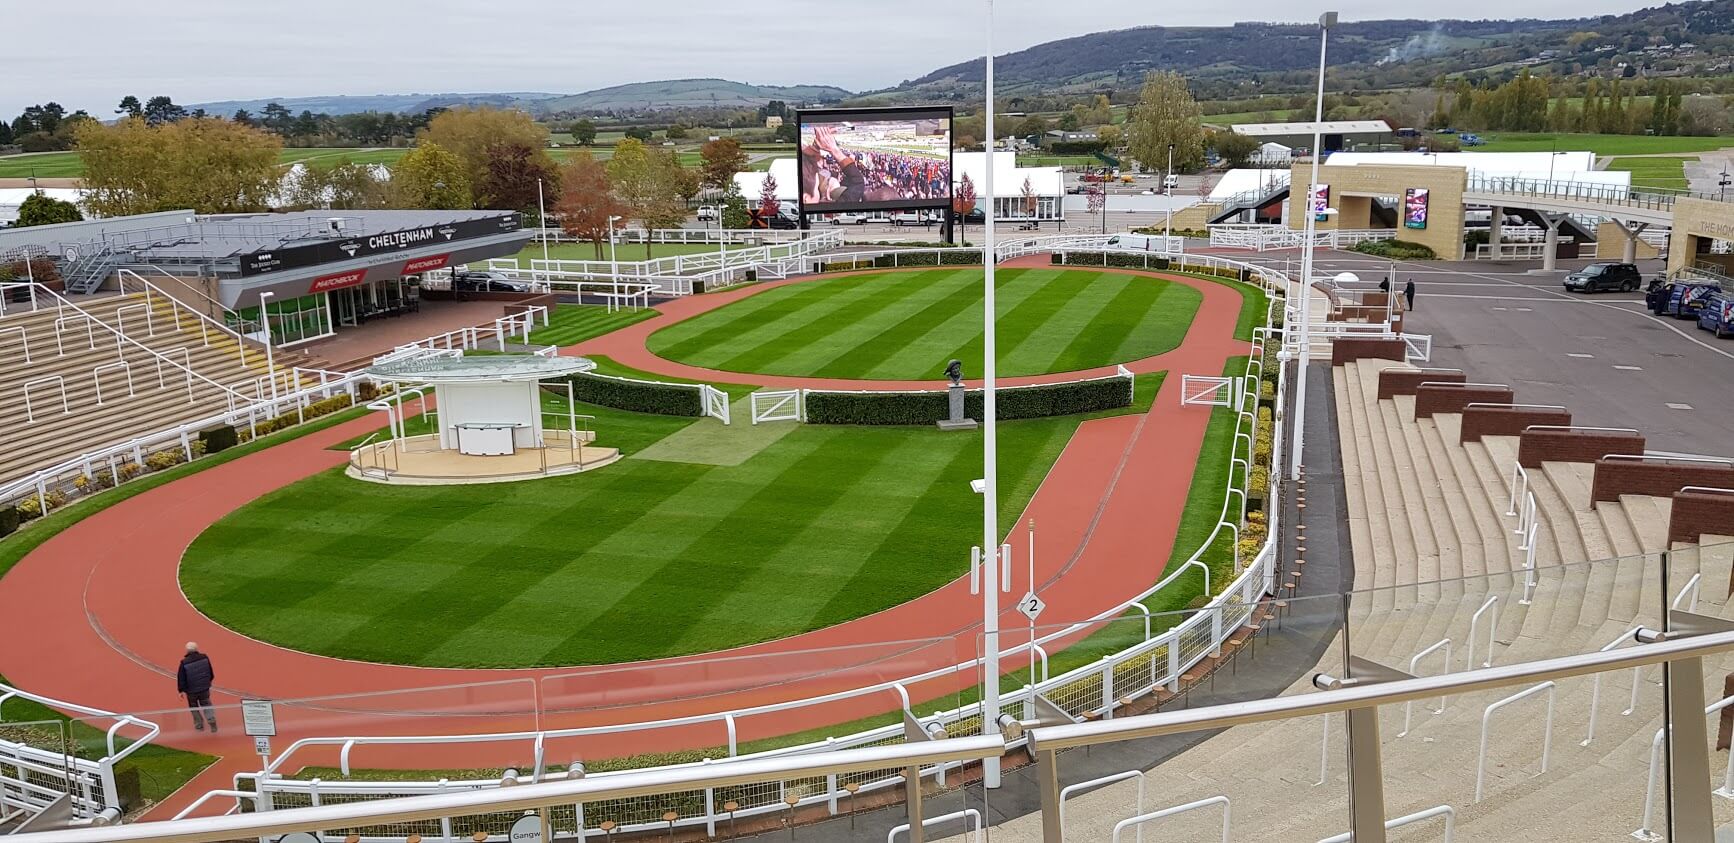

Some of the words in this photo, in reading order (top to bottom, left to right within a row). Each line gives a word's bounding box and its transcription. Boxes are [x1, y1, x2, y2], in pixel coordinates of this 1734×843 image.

[1701, 221, 1716, 233] THE
[369, 228, 433, 248] CHELTENHAM
[406, 257, 444, 271] MATCHBOOK
[315, 274, 361, 289] MATCHBOOK
[1029, 599, 1038, 612] 2
